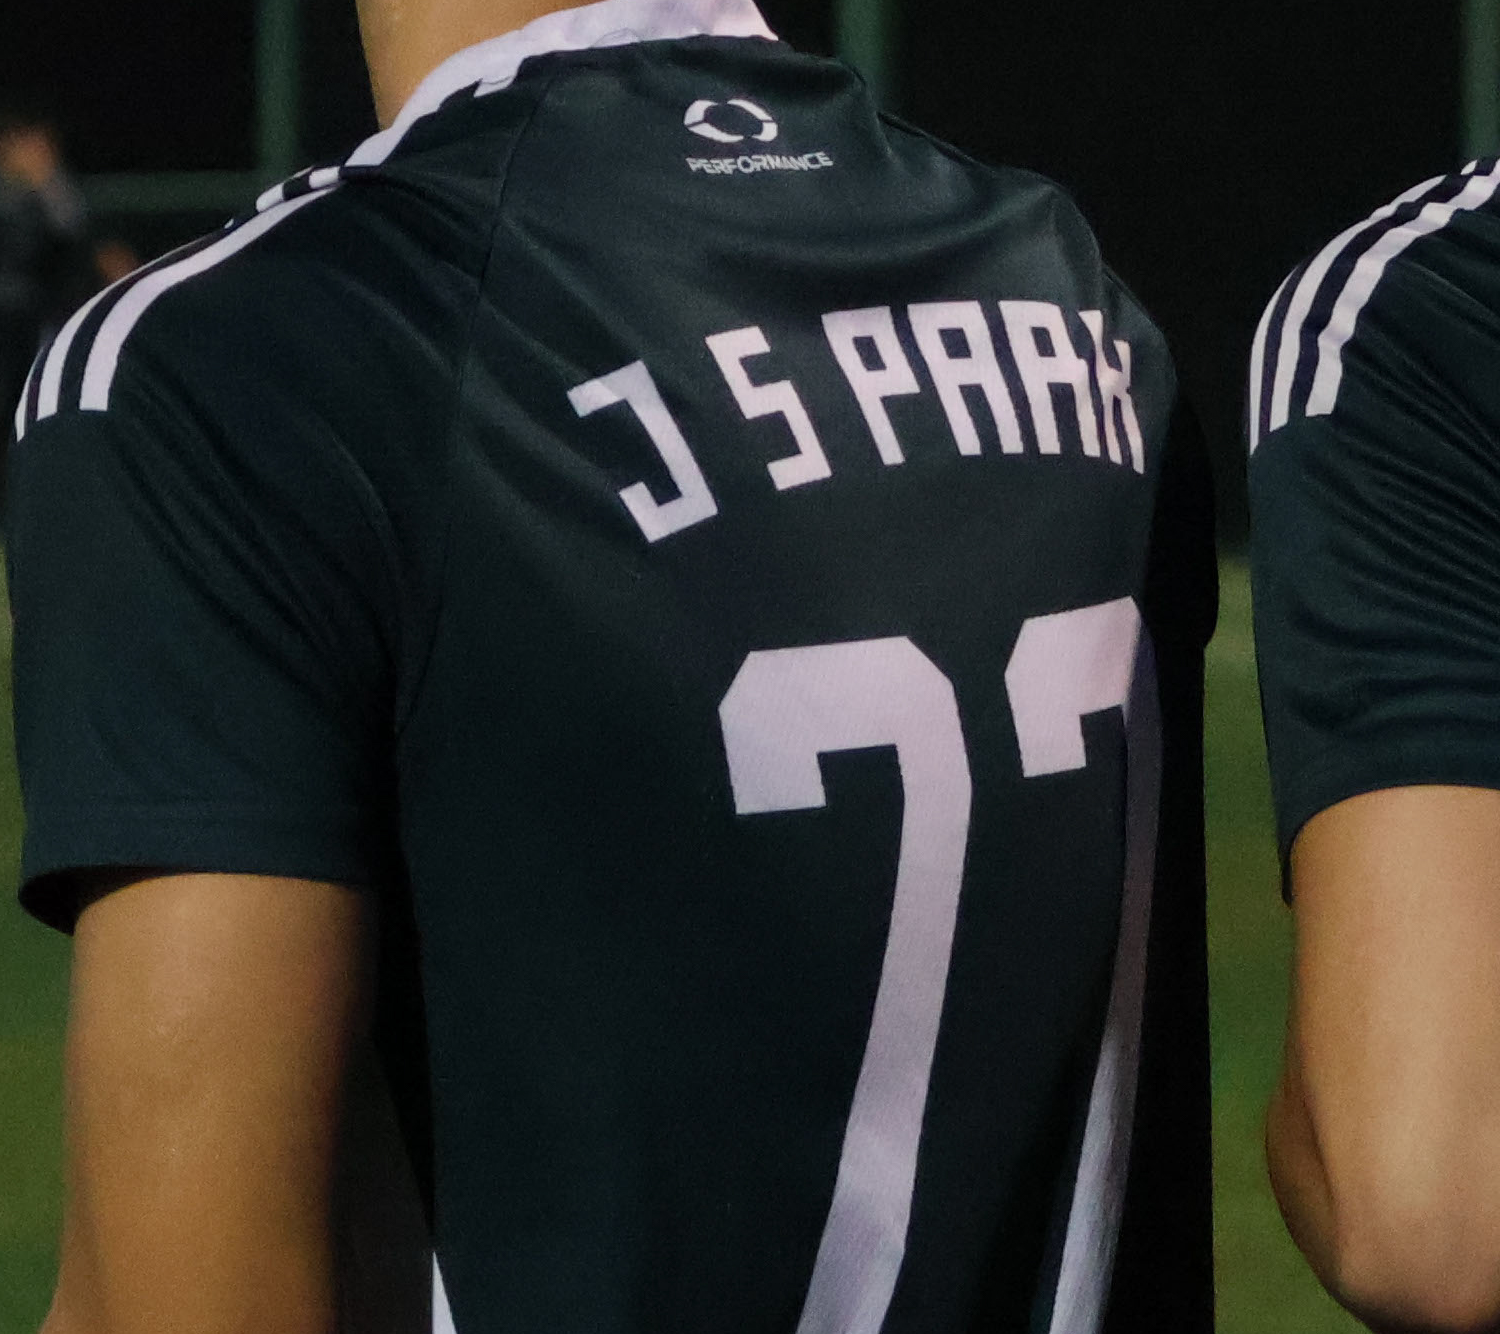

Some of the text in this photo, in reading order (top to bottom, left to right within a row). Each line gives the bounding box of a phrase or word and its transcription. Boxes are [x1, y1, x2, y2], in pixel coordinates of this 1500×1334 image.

[685, 151, 834, 175] PERFORMANCE
[567, 300, 1145, 543] J S PARK
